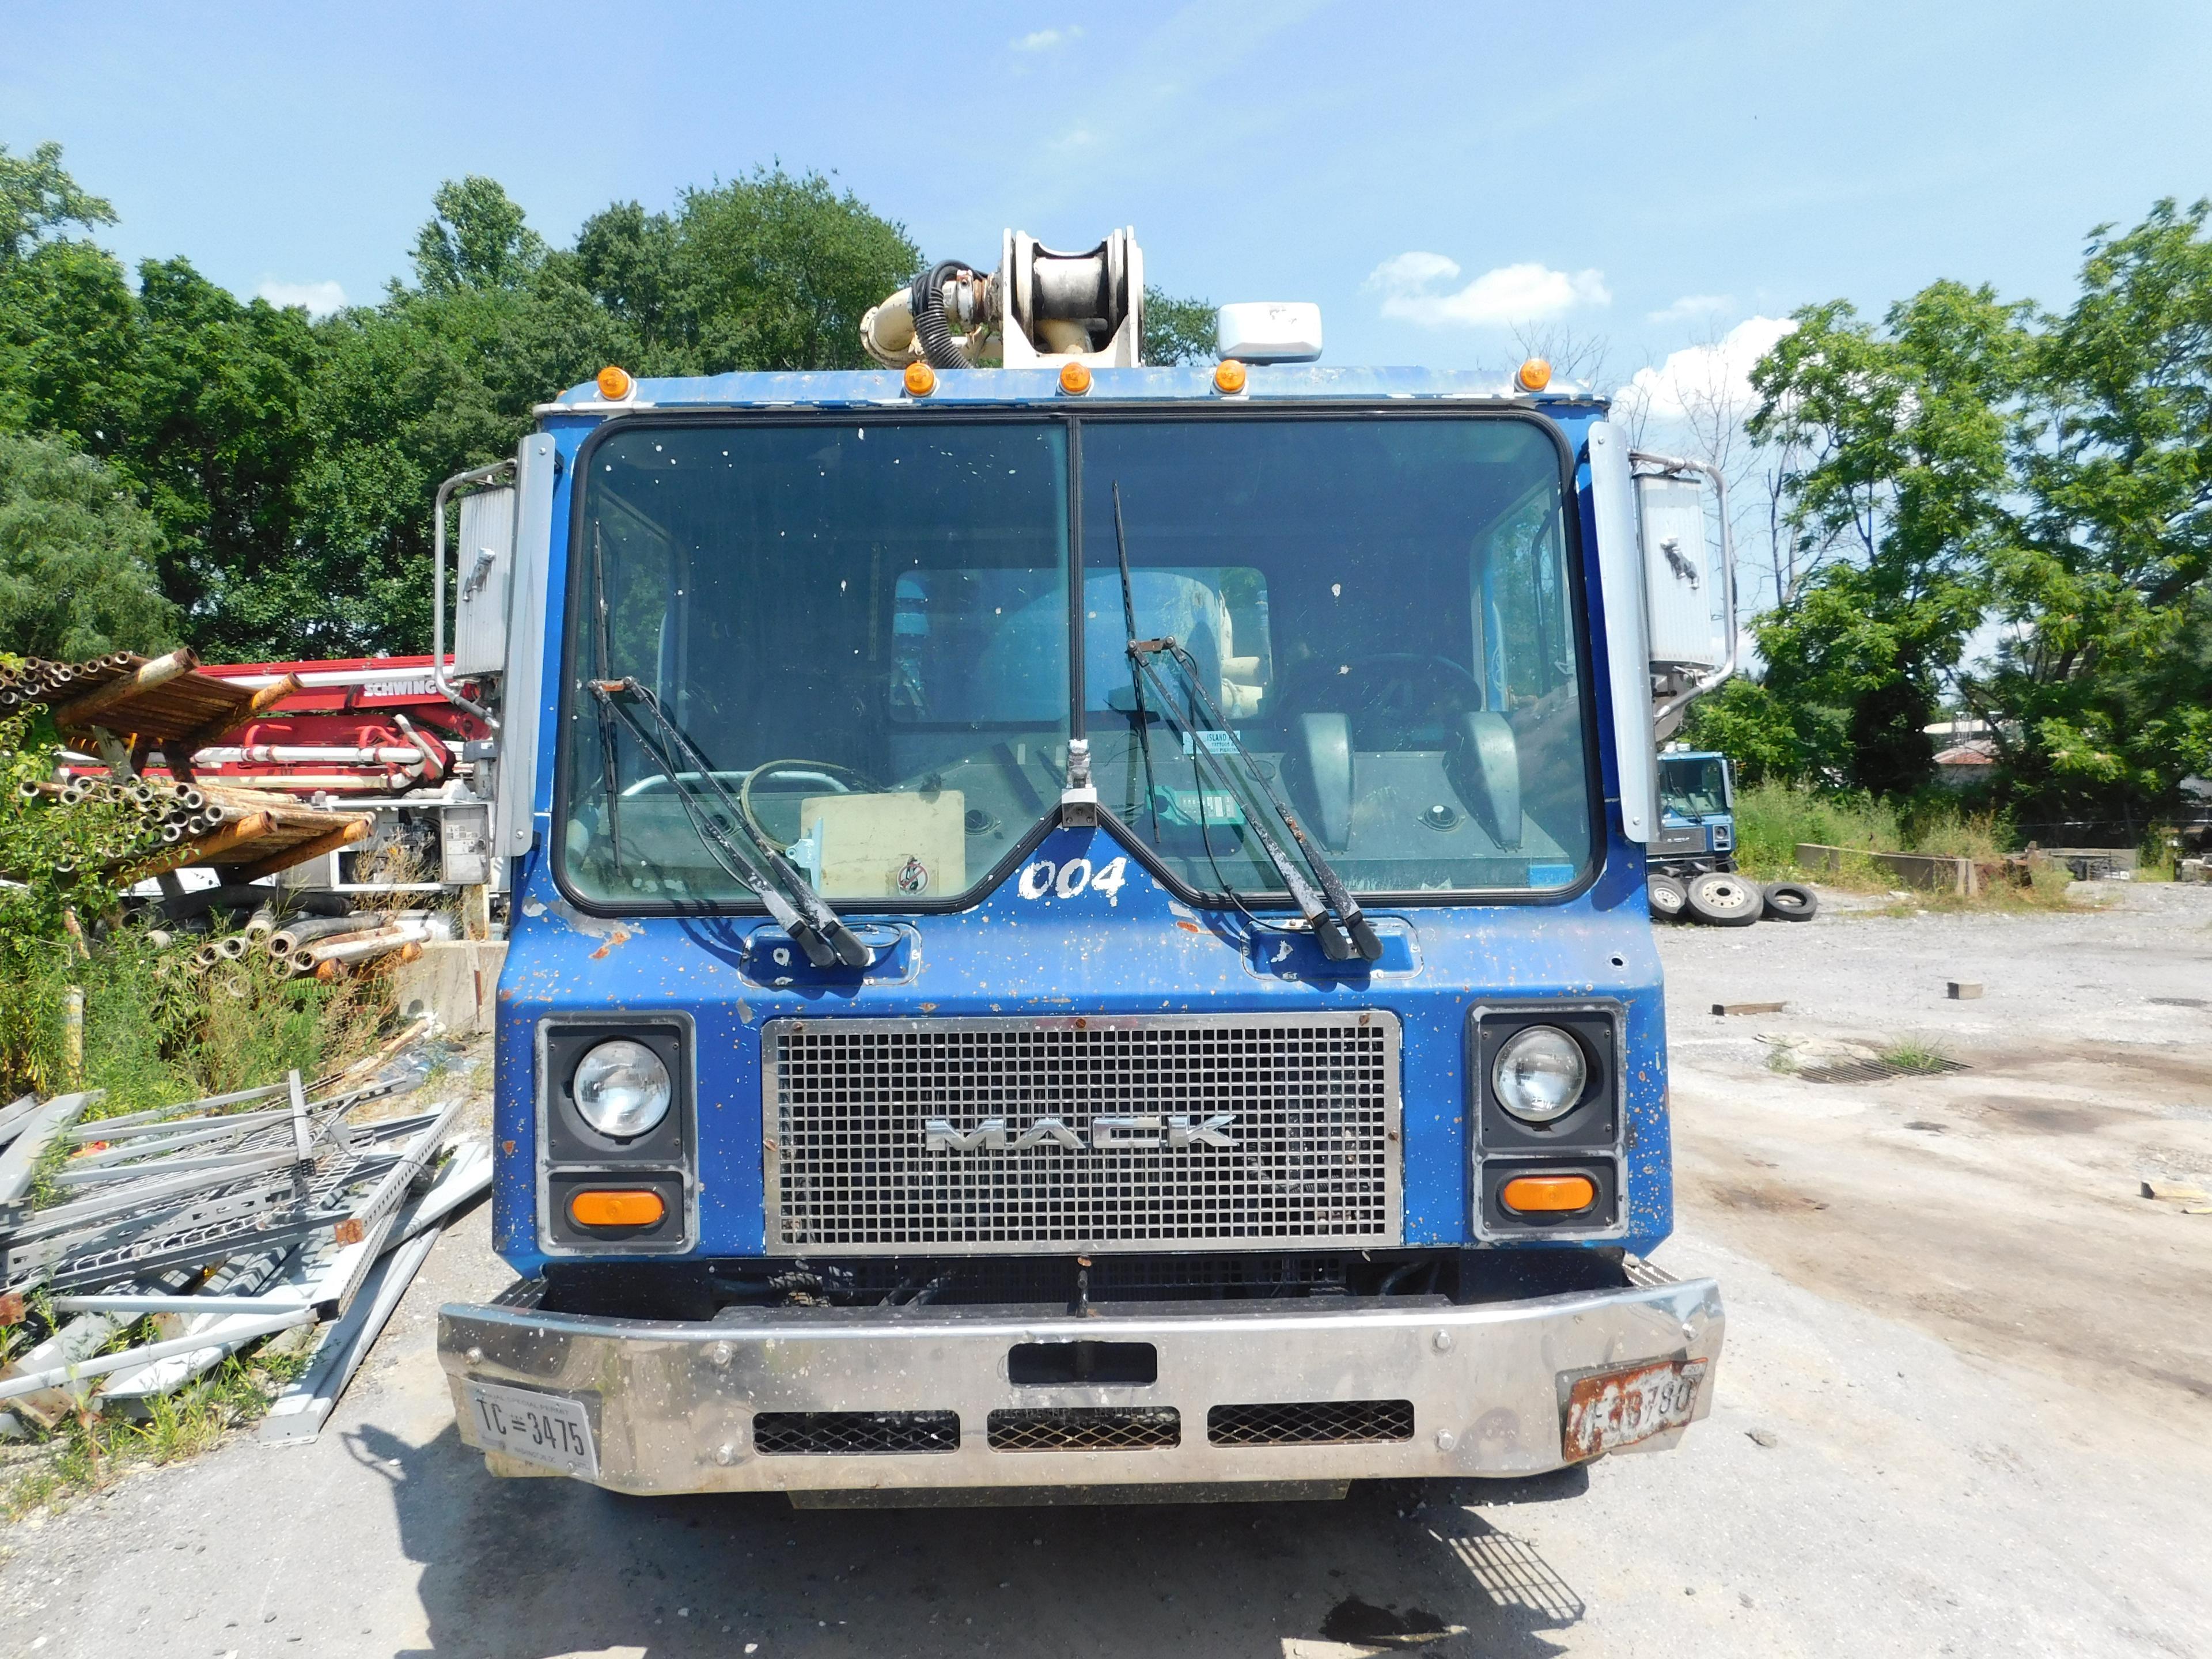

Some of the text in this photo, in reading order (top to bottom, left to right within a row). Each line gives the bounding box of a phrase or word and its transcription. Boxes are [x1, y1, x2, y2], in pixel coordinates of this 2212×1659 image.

[363, 680, 437, 696] SCHWING
[1207, 733, 1226, 741] ISLAND
[1019, 857, 1126, 907] 004
[925, 1115, 1240, 1151] MACK
